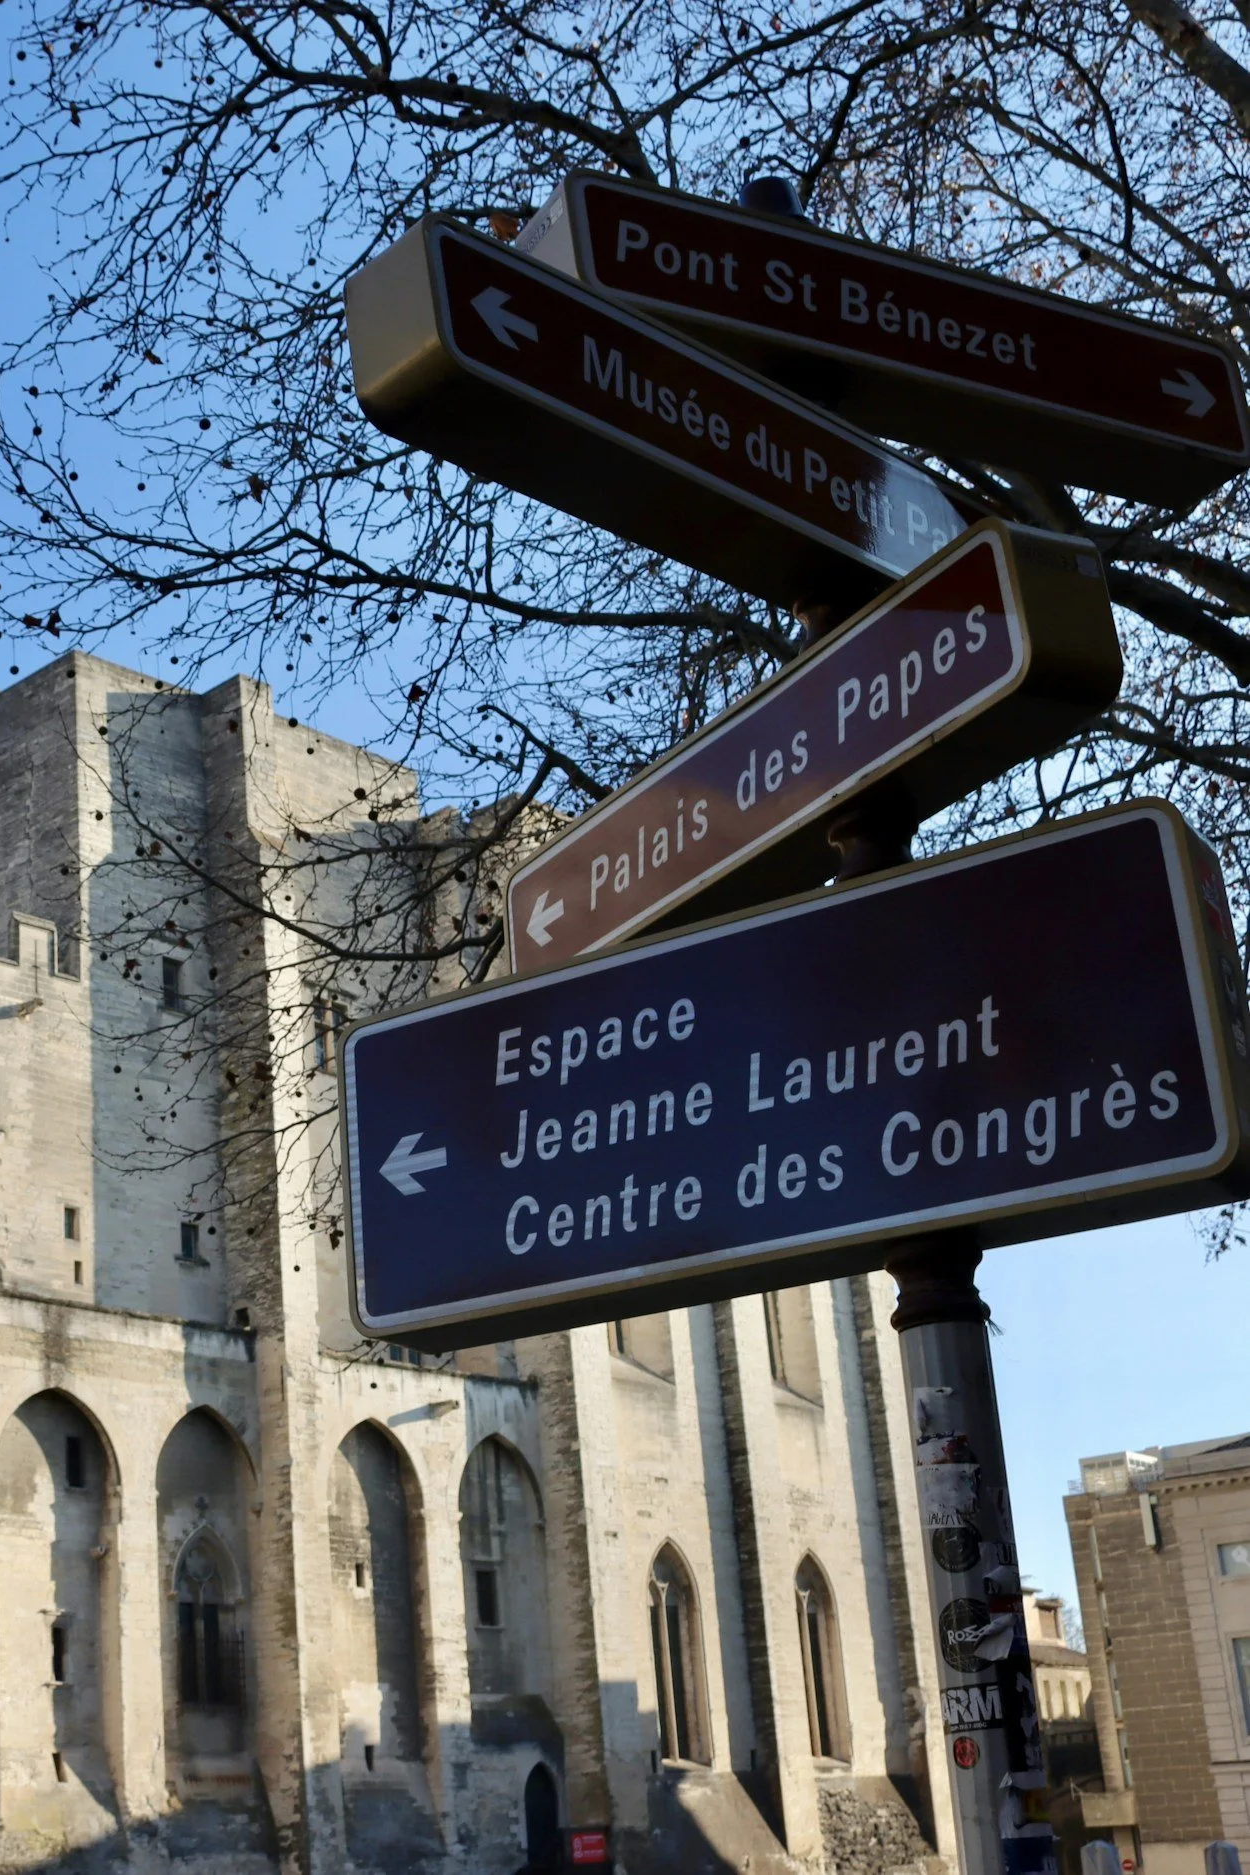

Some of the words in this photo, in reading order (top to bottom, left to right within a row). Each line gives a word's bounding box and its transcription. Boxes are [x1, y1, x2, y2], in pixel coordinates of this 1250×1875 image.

[617, 220, 738, 291] Pont
[764, 260, 817, 311] St
[841, 279, 1036, 370] Bénezet
[584, 335, 730, 450] Musée
[746, 424, 791, 483] du
[803, 448, 898, 537] Petit
[591, 800, 707, 910] Palais
[737, 731, 808, 811] des
[838, 606, 986, 744] Papes
[496, 998, 695, 1085] Espace
[501, 1083, 712, 1168] Jeanne
[749, 996, 998, 1112] Laurent
[506, 1177, 701, 1255] Centre
[737, 1145, 843, 1207] des
[882, 1066, 1178, 1176] Congrès
